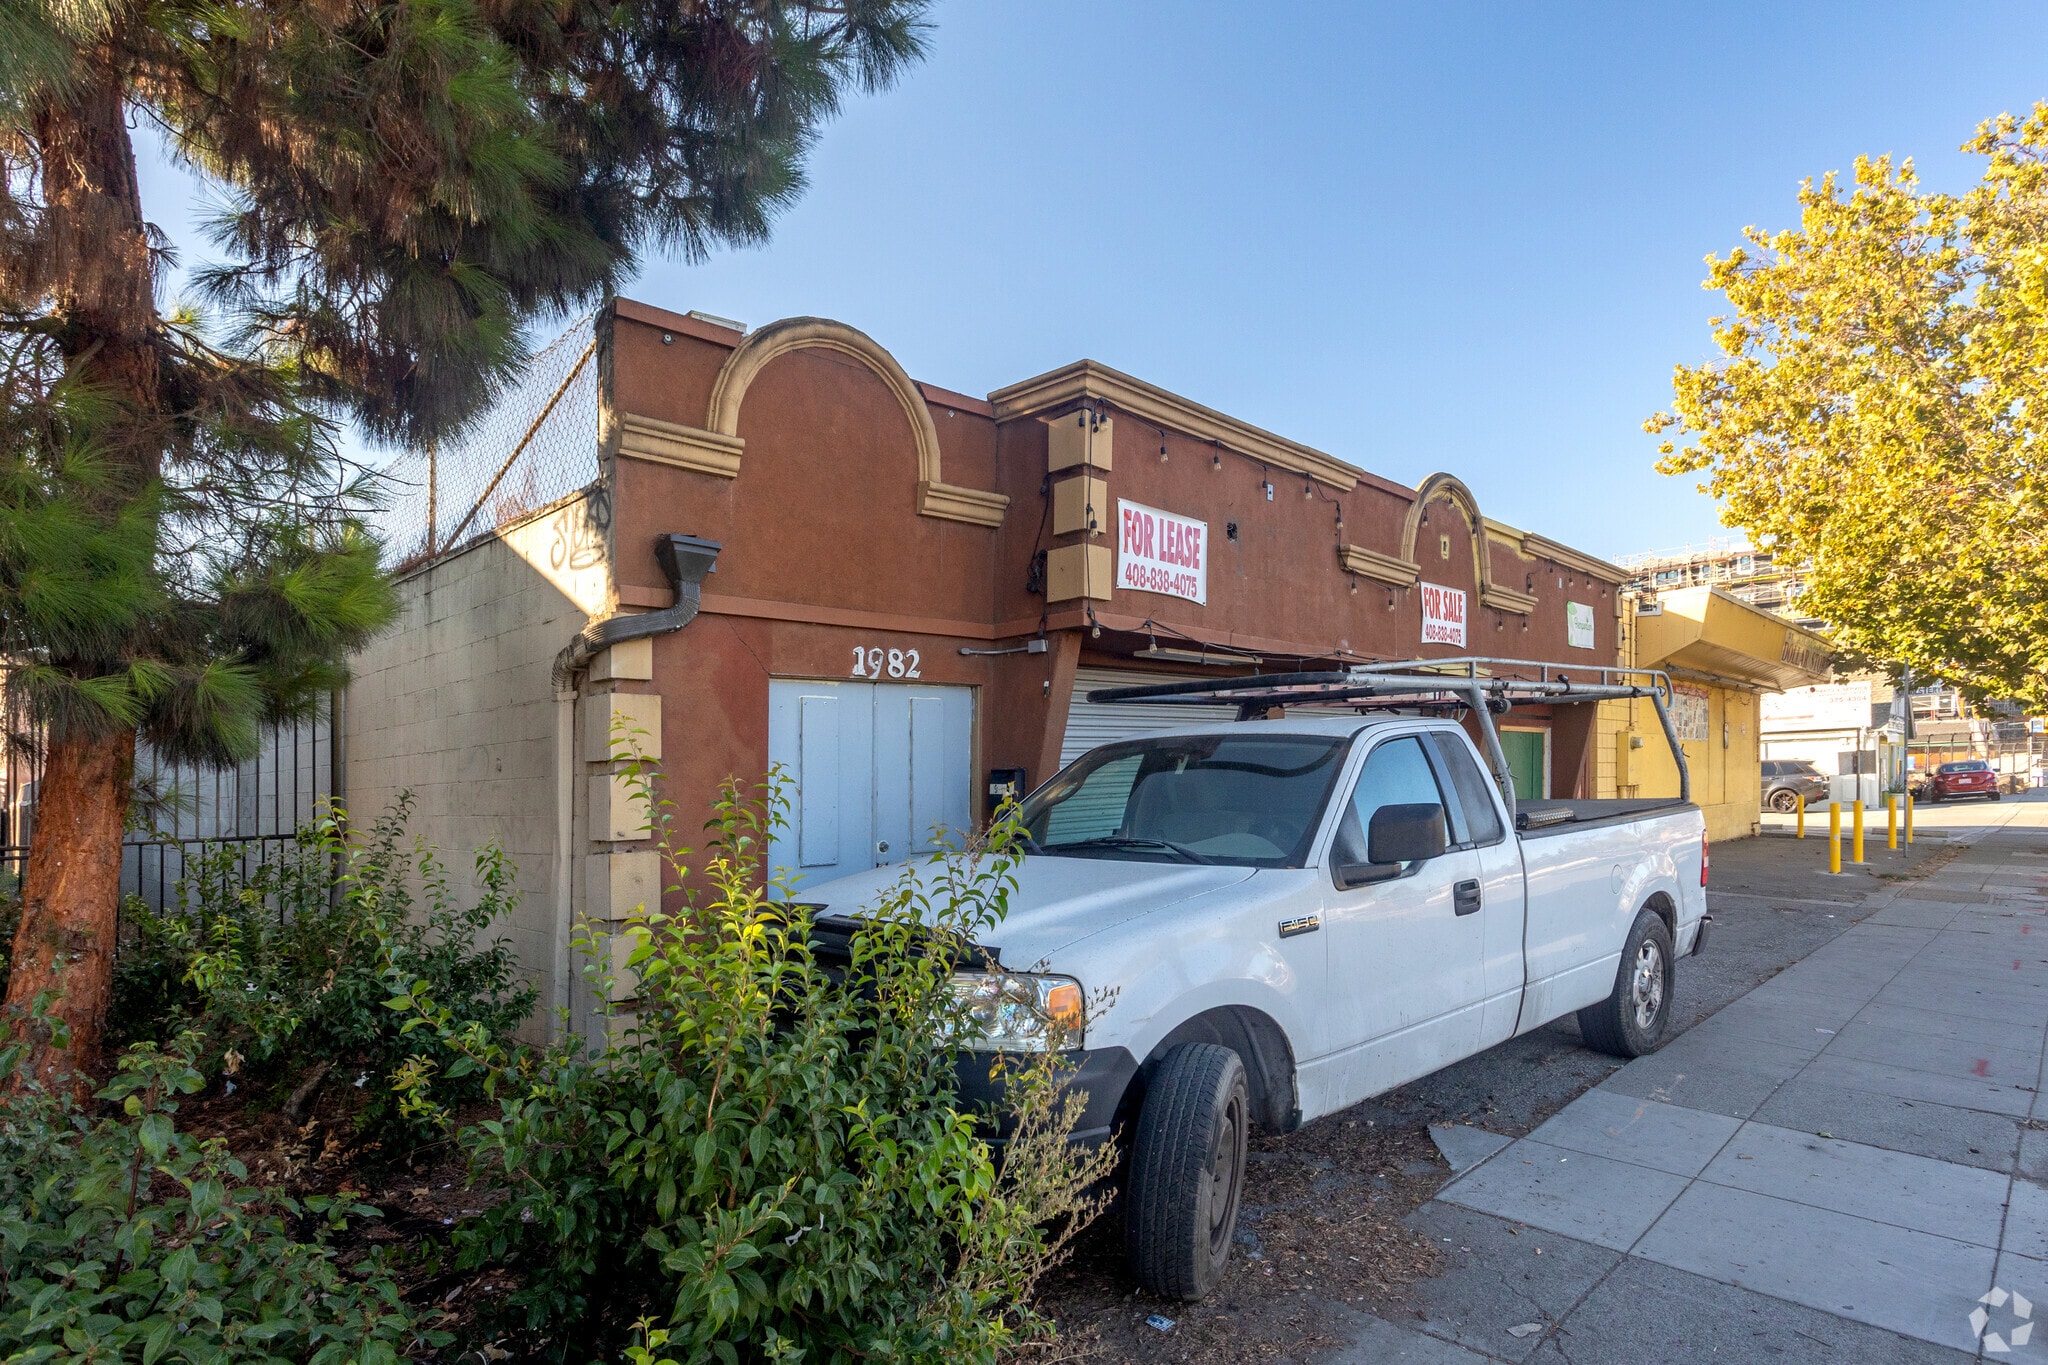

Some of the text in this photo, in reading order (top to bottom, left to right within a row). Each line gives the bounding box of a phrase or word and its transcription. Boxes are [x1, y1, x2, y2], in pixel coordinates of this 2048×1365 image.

[1124, 508, 1201, 570] FOR LEASE
[1125, 563, 1198, 597] 408-838-4075
[1423, 587, 1462, 623] FOR SALE
[852, 646, 921, 679] 1982
[1781, 641, 1809, 669] DOLLAR
